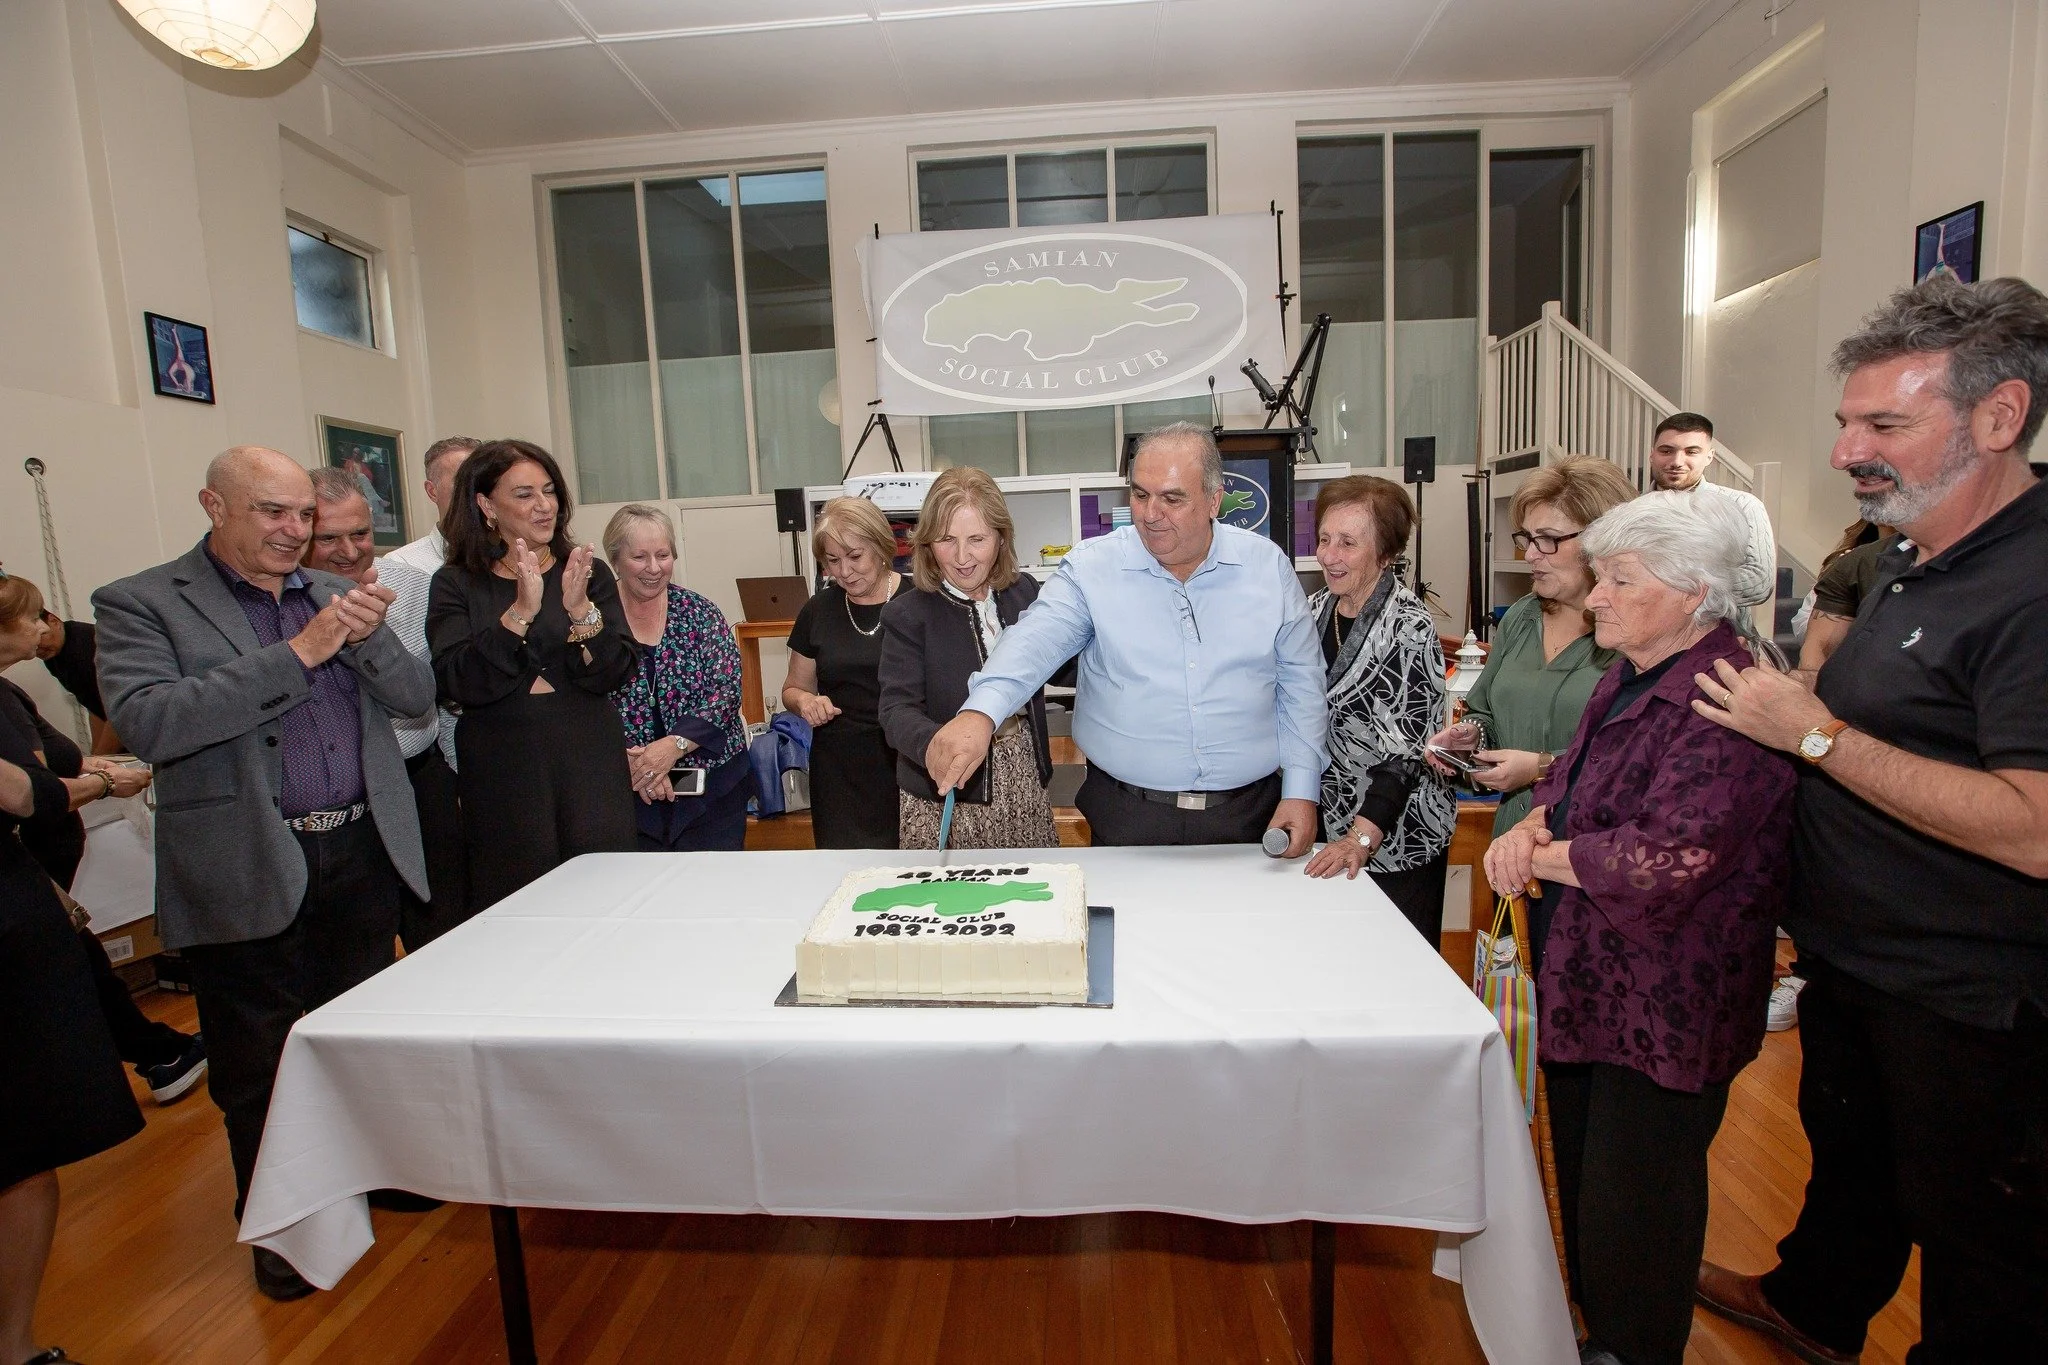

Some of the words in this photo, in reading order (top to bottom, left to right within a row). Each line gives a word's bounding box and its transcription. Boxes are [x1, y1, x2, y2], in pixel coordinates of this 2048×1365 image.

[984, 249, 1120, 278] SAMIAN
[938, 357, 1060, 390] SOCIAL
[1074, 348, 1169, 387] CLUB
[945, 867, 1029, 877] YEARS
[876, 913, 941, 923] SOCIAL
[956, 912, 1006, 923] CLUB
